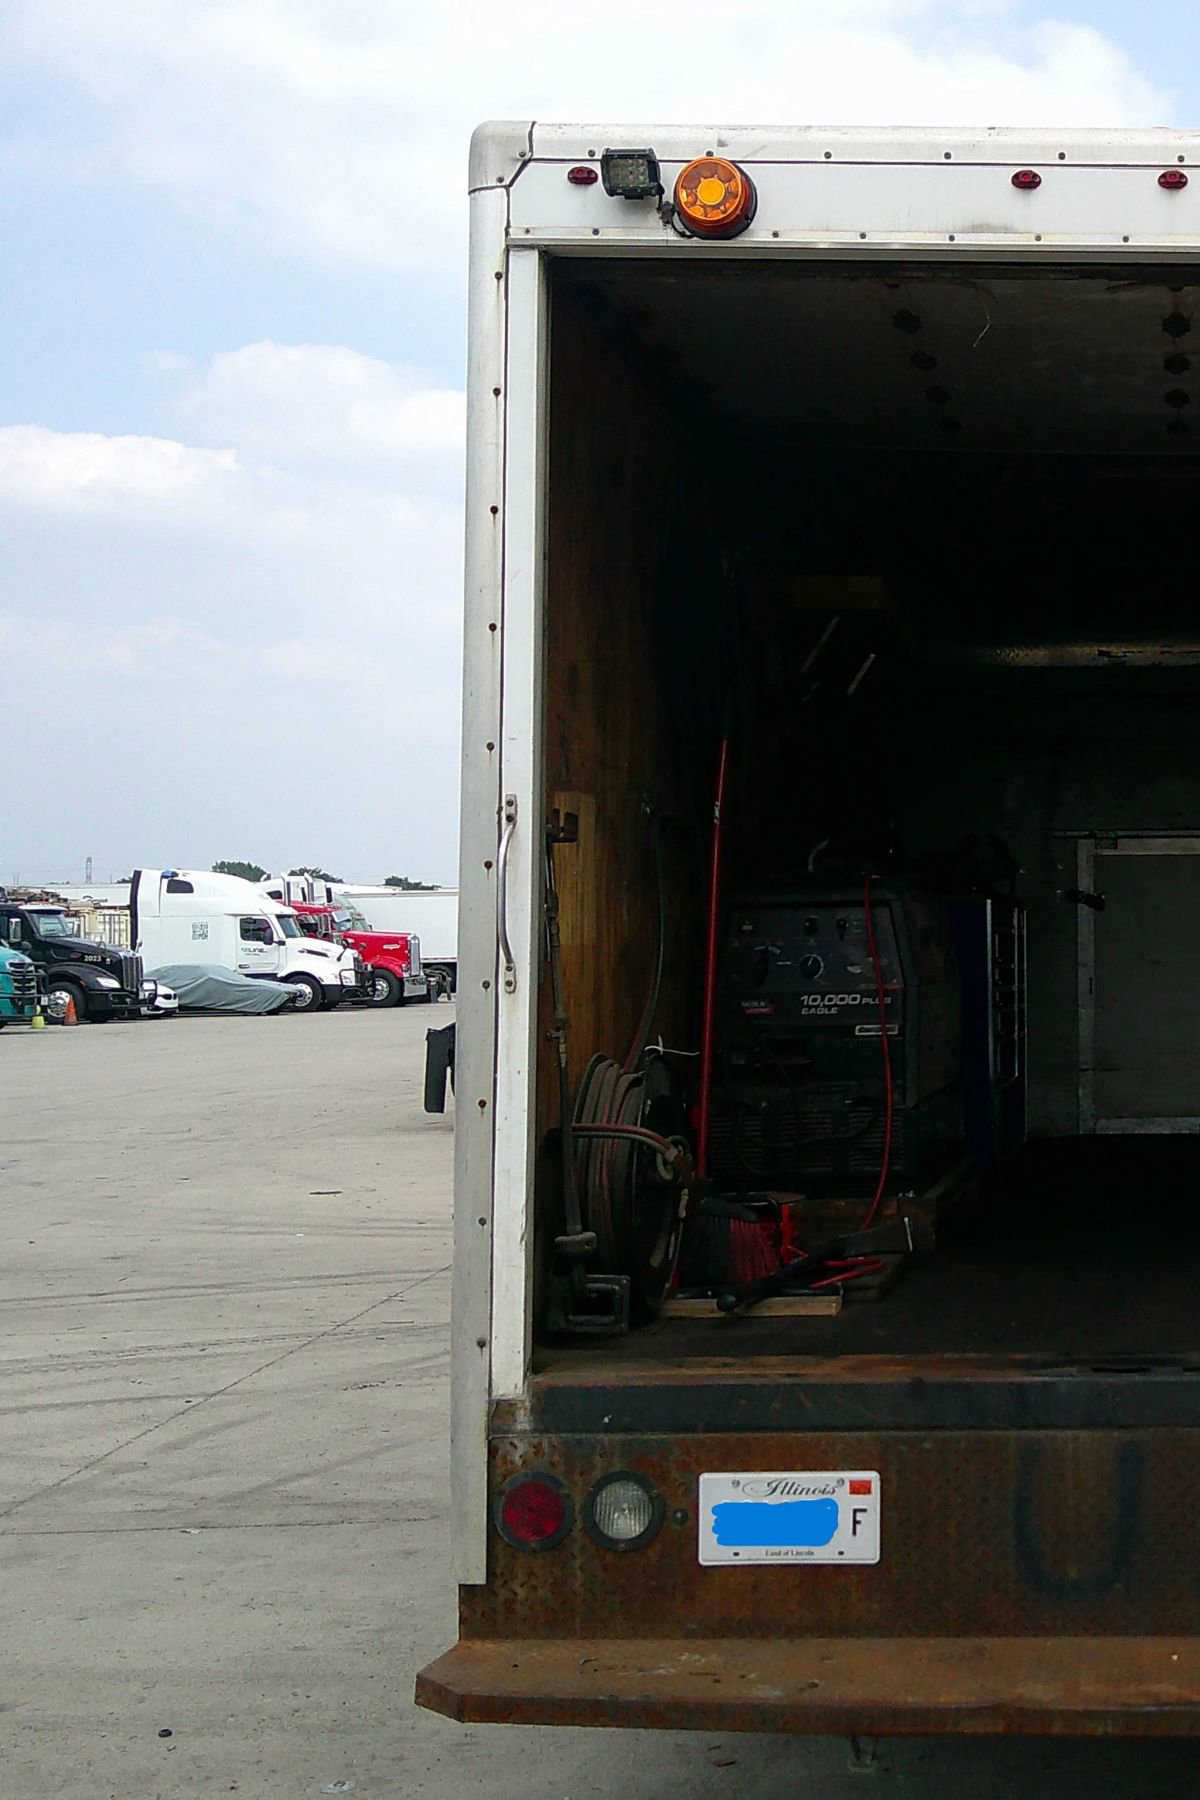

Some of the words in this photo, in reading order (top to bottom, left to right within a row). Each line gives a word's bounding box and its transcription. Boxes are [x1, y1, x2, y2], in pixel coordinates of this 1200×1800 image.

[800, 993, 861, 1007] 10,000
[801, 1006, 839, 1015] EAGLE
[742, 1478, 838, 1497] Illinois
[851, 1508, 868, 1537] F
